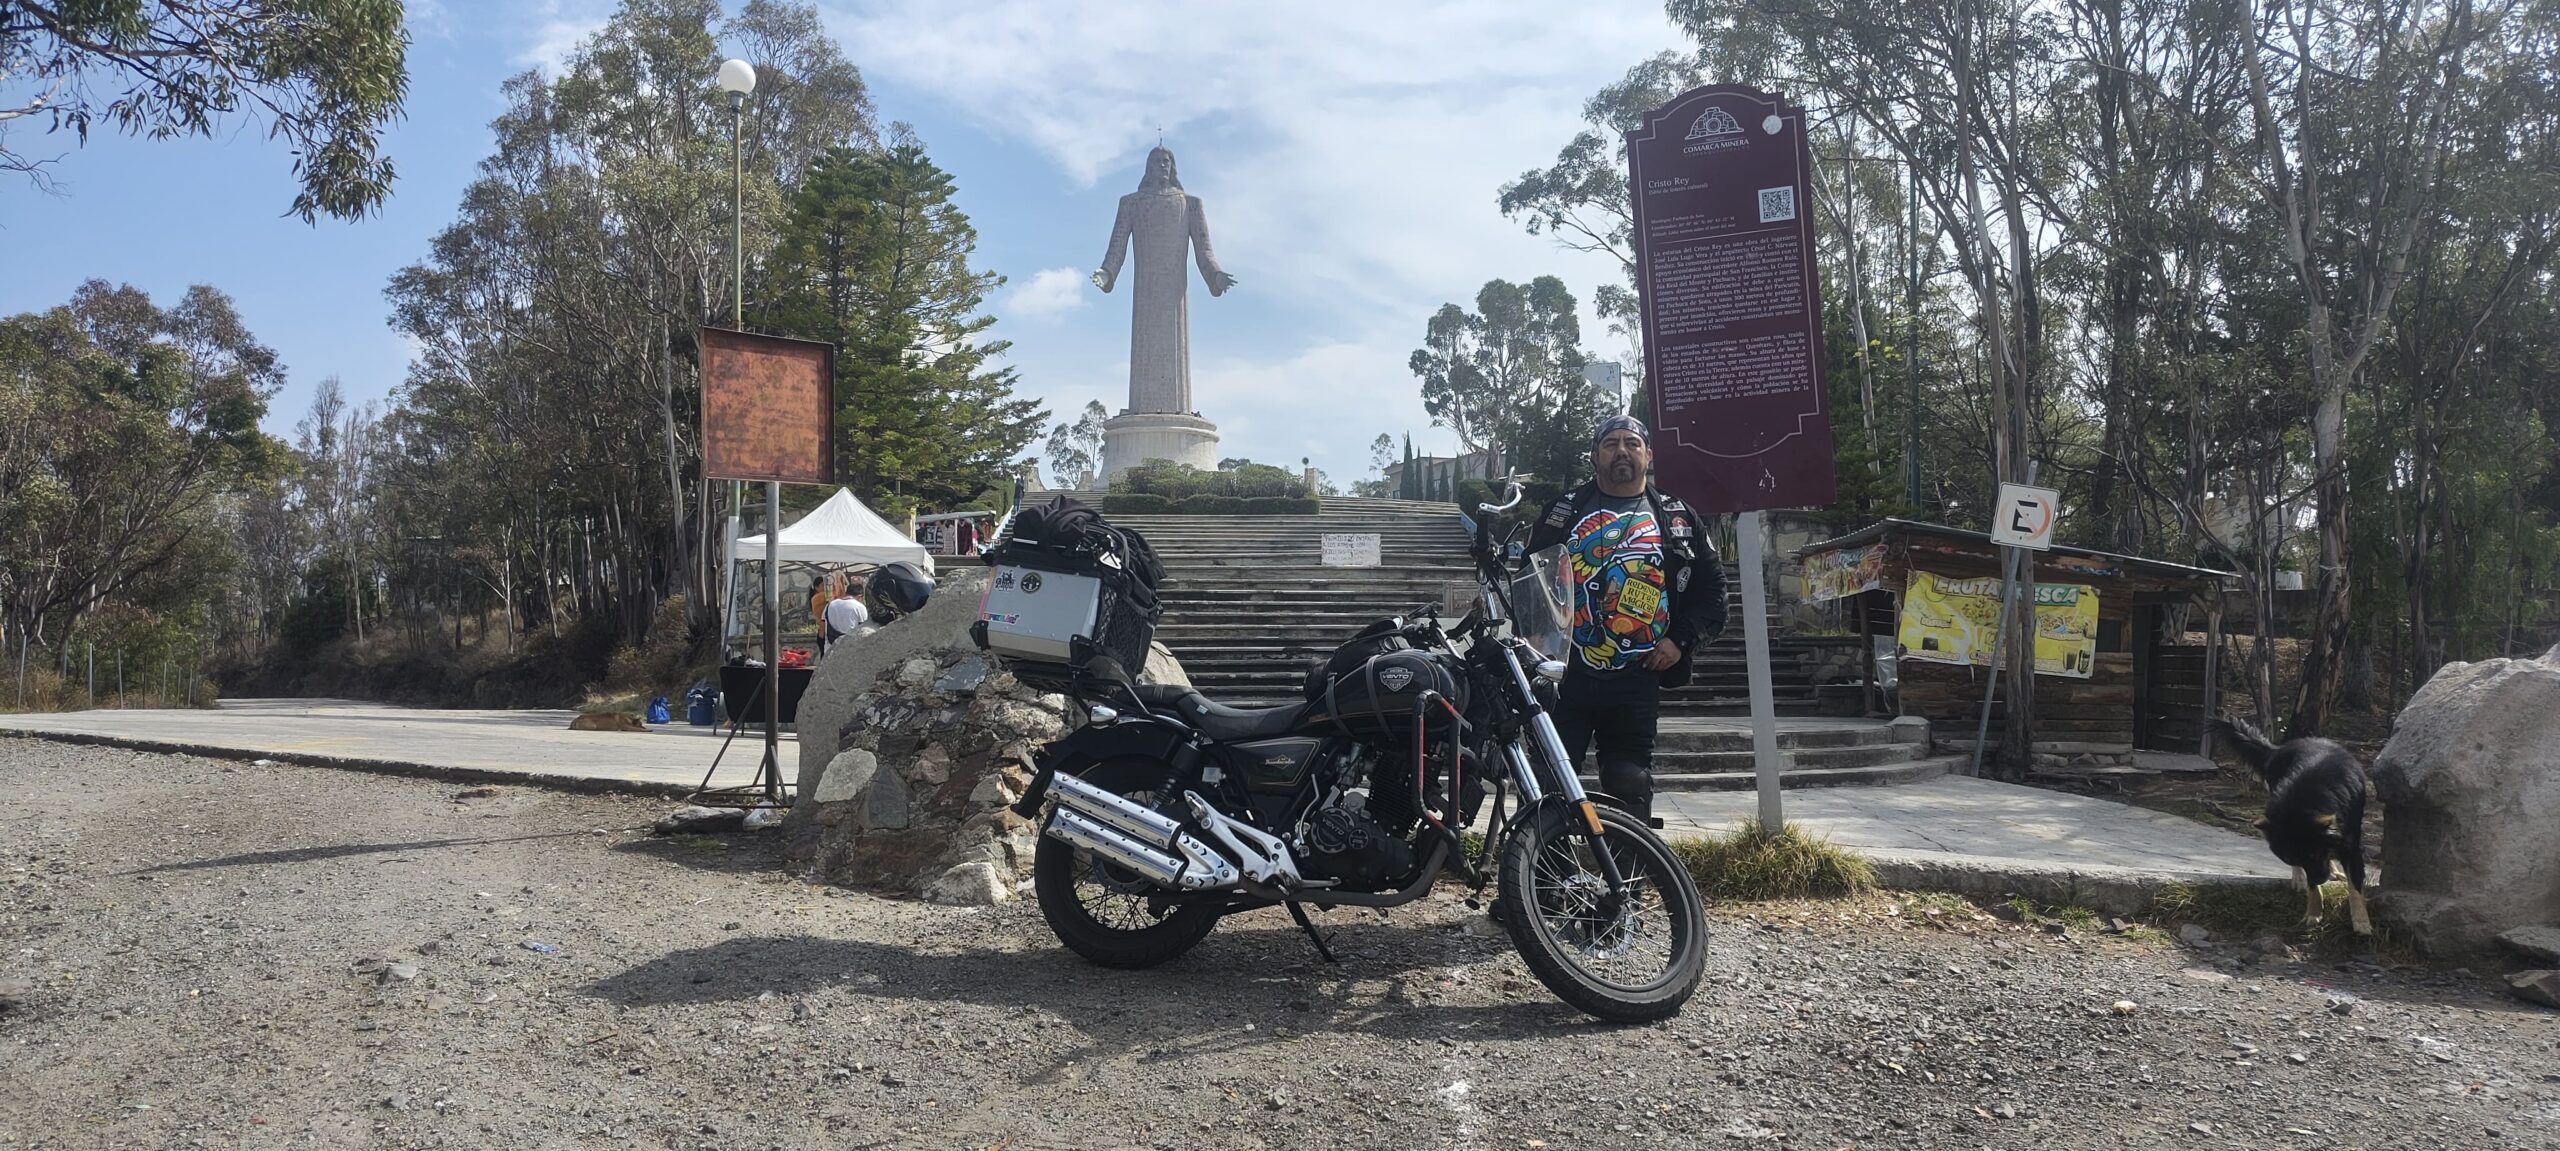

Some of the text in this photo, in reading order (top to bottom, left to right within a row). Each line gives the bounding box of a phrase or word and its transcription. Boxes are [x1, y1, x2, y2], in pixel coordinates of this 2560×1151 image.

[1683, 142, 1720, 154] COMARCA
[1720, 138, 1750, 148] MINERA
[1648, 176, 1690, 188] Cristo Rey
[1650, 556, 1661, 566] N
[1934, 576, 1998, 596] FRUTA
[1621, 638, 1632, 648] S
[1322, 817, 1344, 836] VENTO
